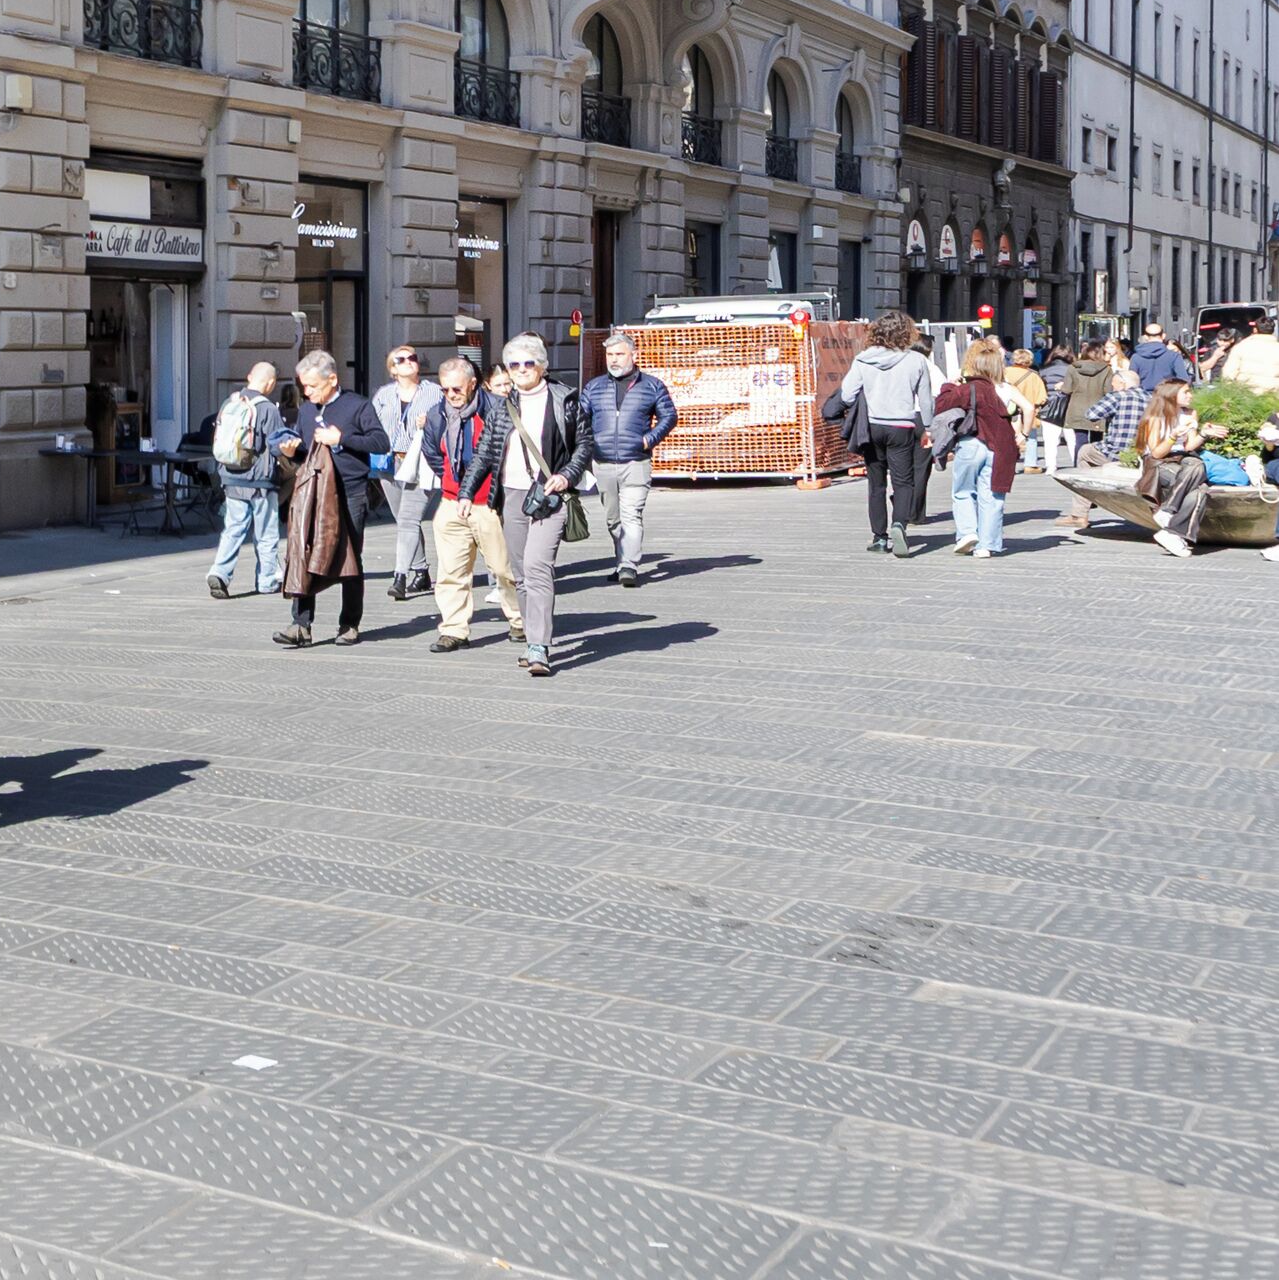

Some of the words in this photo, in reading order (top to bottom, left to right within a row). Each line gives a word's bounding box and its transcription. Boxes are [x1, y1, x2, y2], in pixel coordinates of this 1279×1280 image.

[135, 229, 151, 253] del
[152, 228, 200, 256] Battistero
[312, 239, 335, 248] MILANO
